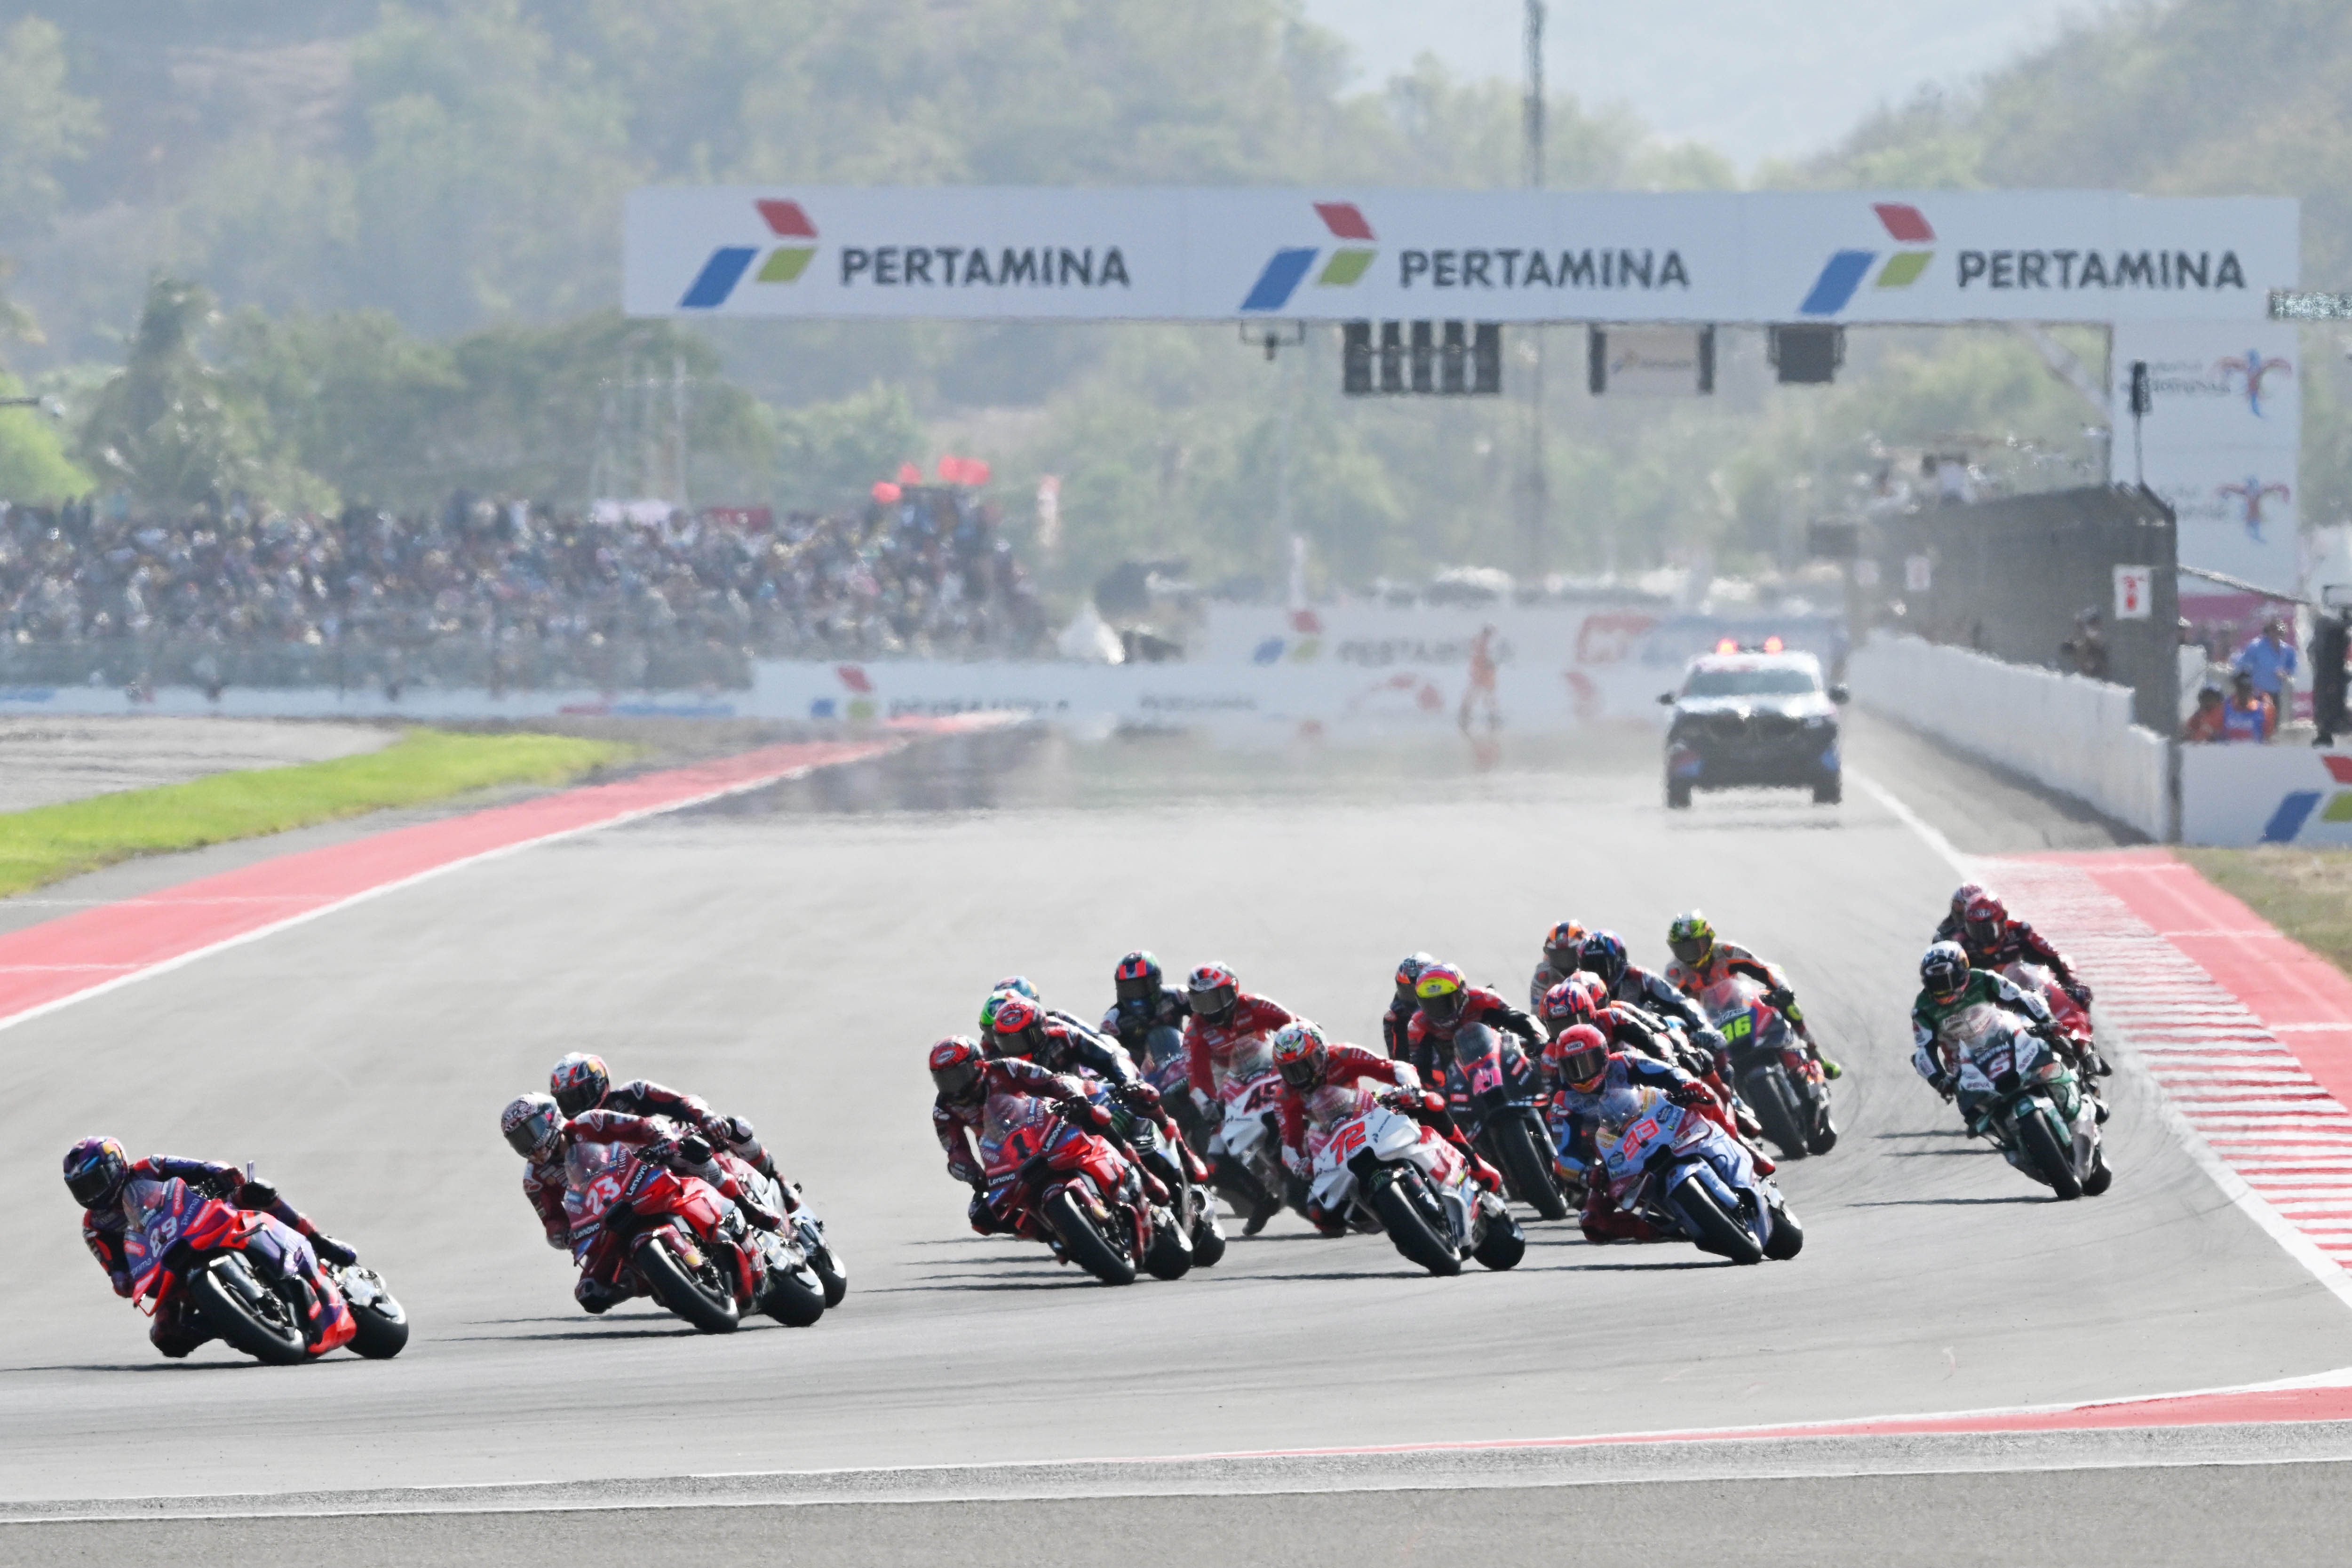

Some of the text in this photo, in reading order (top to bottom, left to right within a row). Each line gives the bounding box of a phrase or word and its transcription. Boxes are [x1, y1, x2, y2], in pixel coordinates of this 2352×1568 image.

[840, 246, 1130, 287] PERTAMINA
[1398, 248, 1690, 289] PERTAMINA
[1957, 249, 2246, 290] PERTAMINA
[1330, 1121, 1366, 1166] 72
[1623, 1118, 1660, 1162] 93
[585, 1176, 621, 1216] 23
[625, 1164, 648, 1196] Lenovo
[988, 1173, 1016, 1186] Lenovo
[149, 1216, 177, 1258] 89
[573, 1223, 601, 1240] Lenovo
